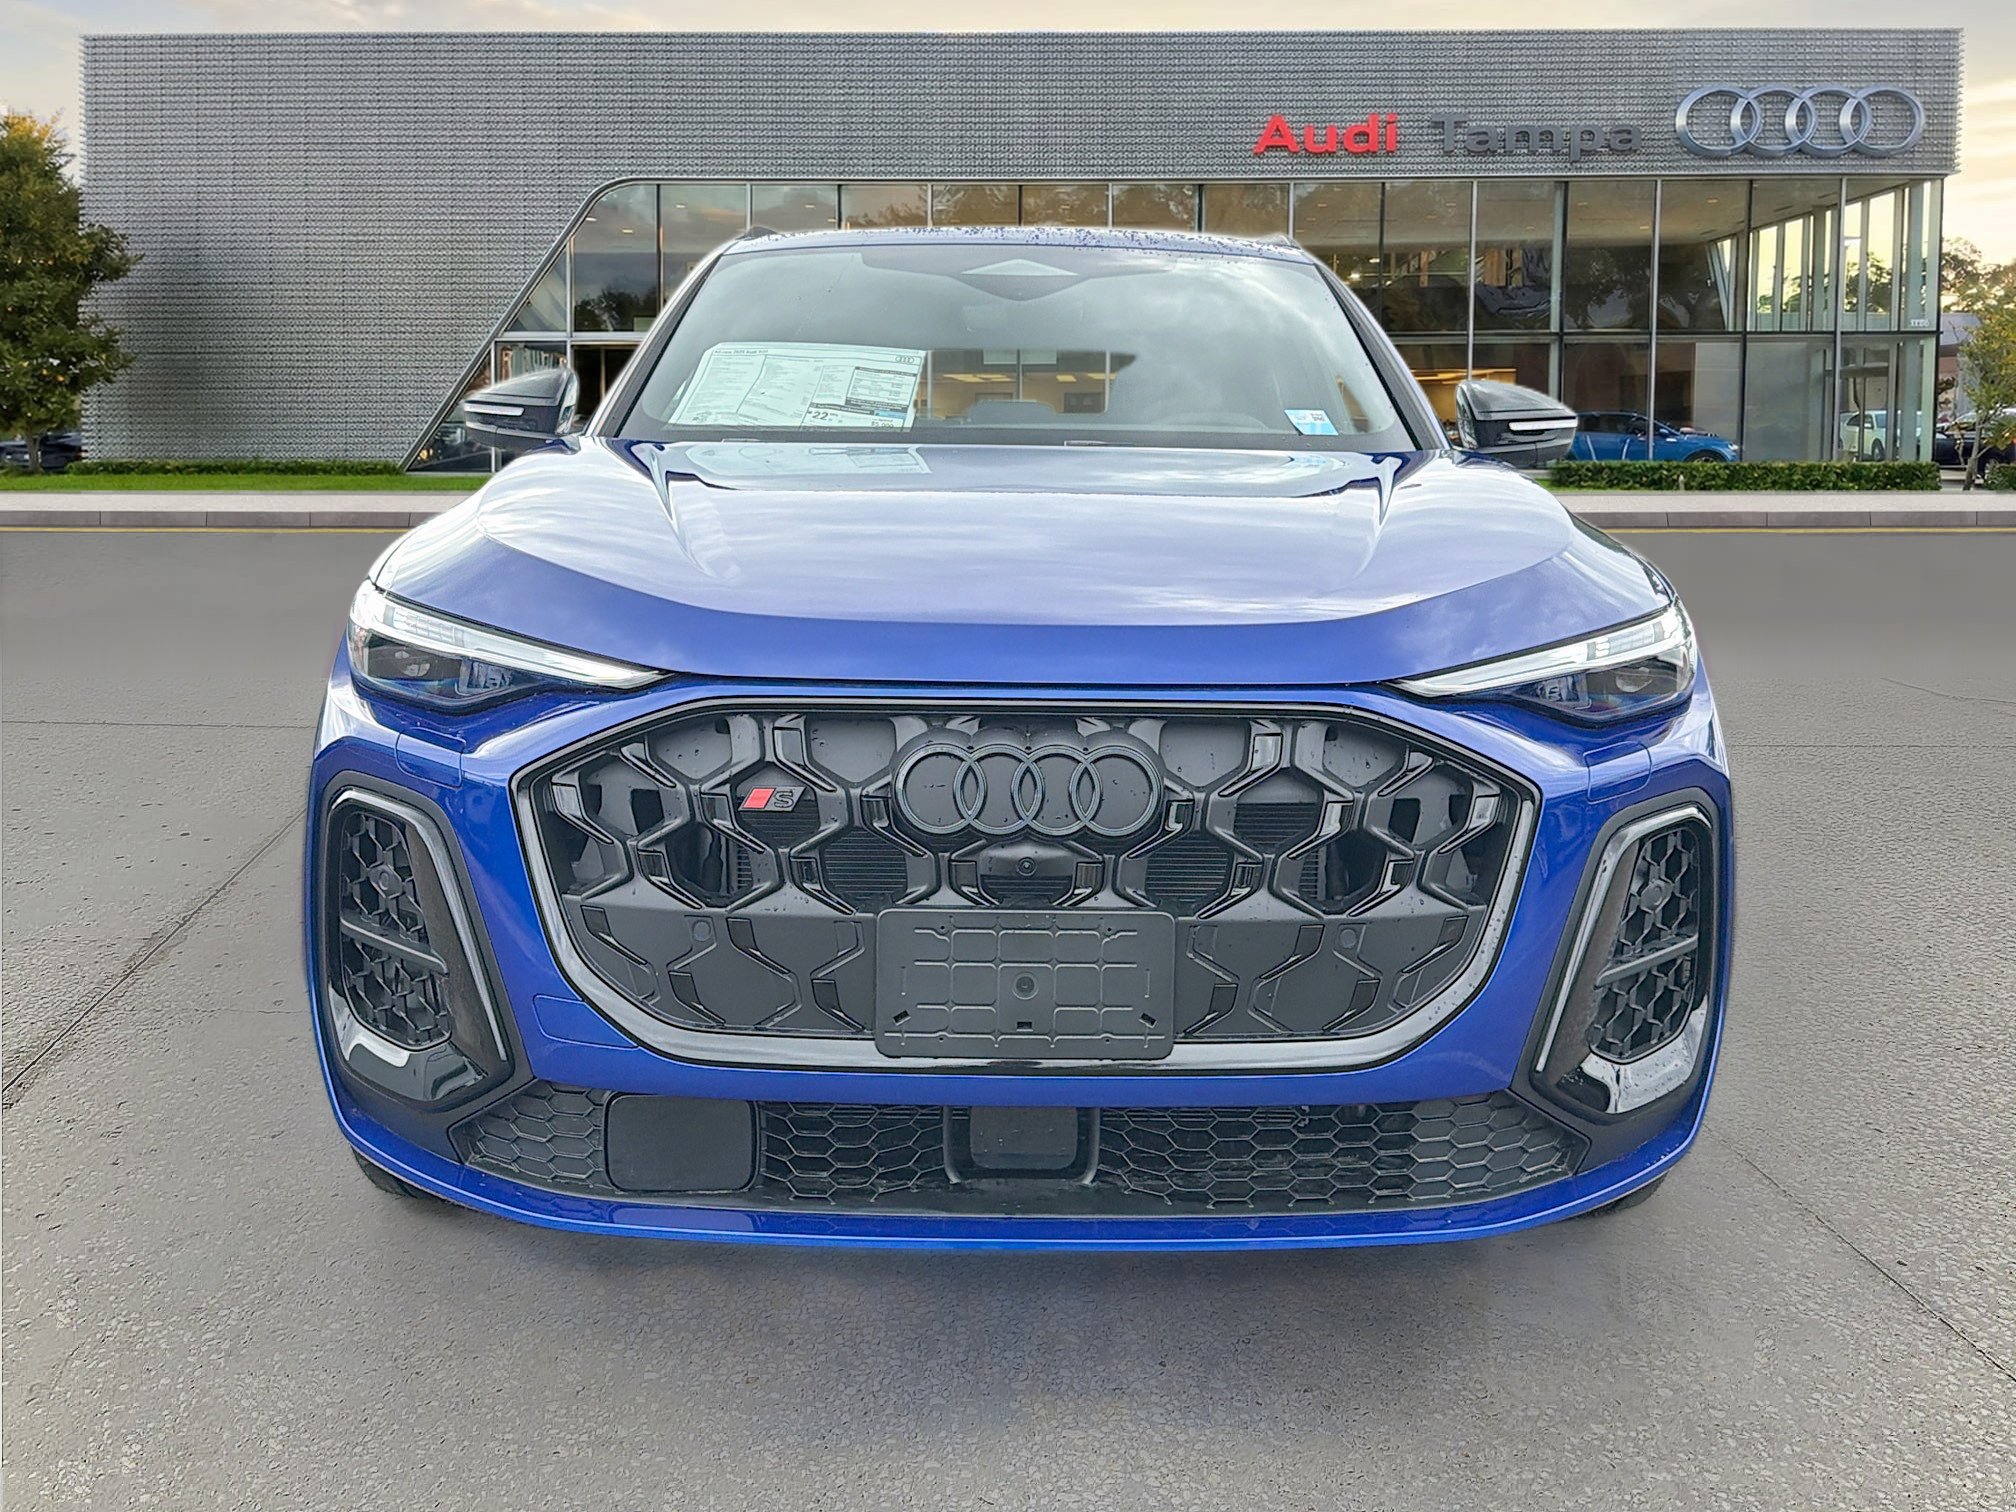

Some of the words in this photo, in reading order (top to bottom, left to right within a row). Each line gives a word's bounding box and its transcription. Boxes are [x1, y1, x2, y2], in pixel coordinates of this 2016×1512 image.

[1253, 113, 1397, 153] Audi
[1430, 112, 1642, 163] Tampa
[812, 410, 829, 421] 22
[774, 789, 794, 808] S
